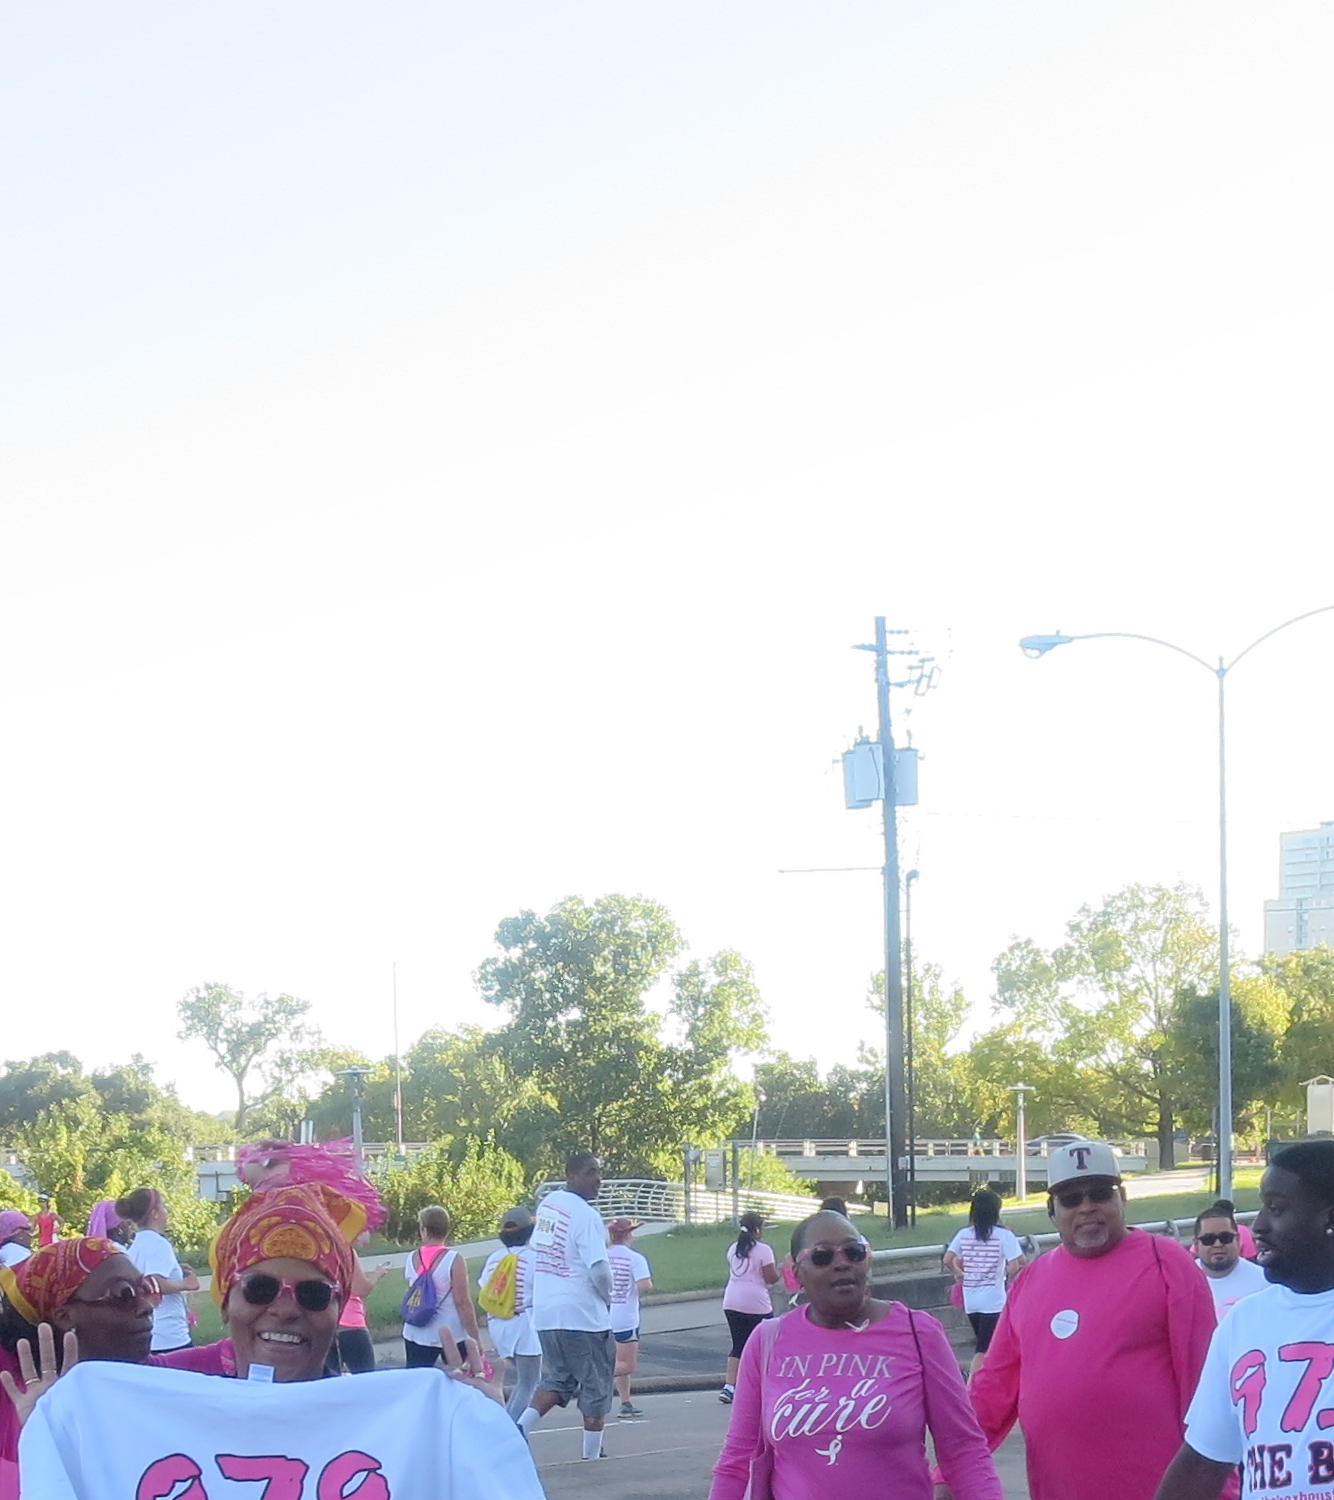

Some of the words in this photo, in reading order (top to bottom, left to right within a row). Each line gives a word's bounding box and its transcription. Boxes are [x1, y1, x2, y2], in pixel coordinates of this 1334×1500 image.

[1069, 1147, 1091, 1171] T
[776, 1354, 814, 1378] IN
[816, 1352, 897, 1378] PINK
[773, 1378, 831, 1412] for
[851, 1378, 879, 1399] a
[771, 1394, 892, 1442] cure
[1246, 1442, 1293, 1493] HE
